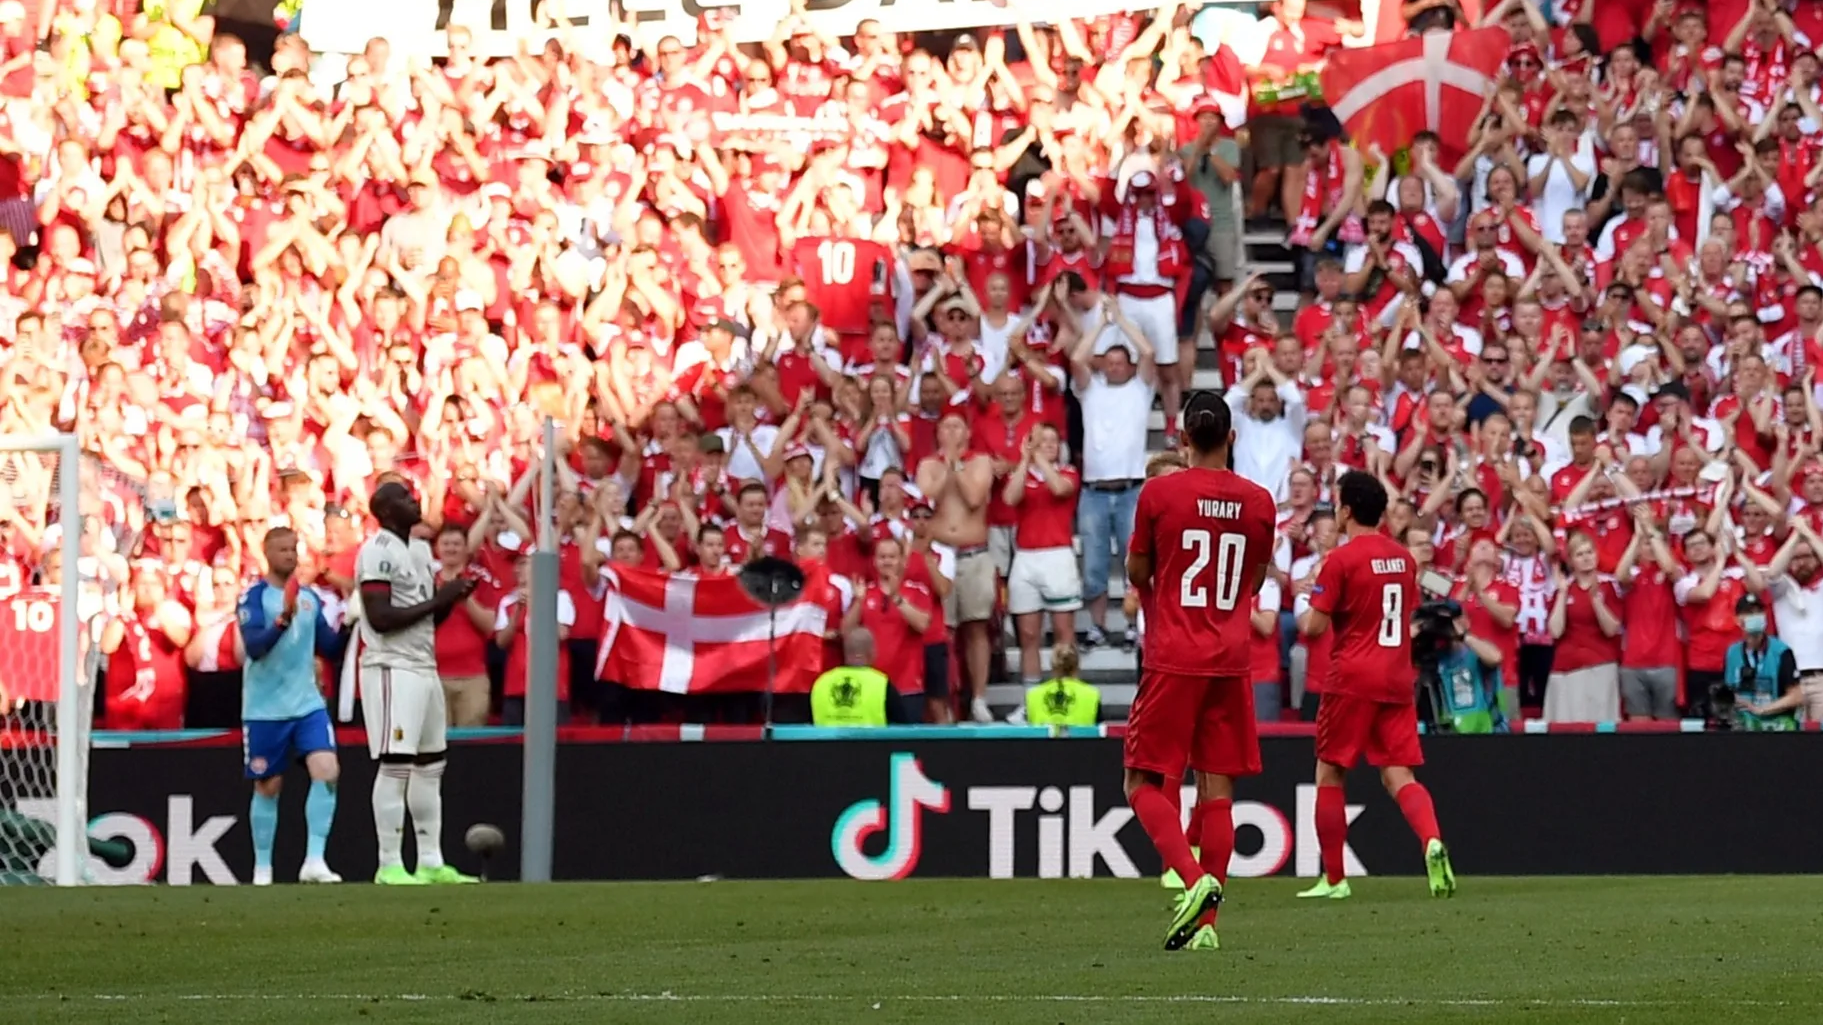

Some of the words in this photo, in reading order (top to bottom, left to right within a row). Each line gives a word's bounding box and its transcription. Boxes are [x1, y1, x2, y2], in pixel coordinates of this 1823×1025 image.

[817, 240, 856, 285] 10
[1197, 498, 1242, 520] YURARY
[1181, 529, 1247, 611] 20
[10, 599, 55, 633] 10
[1378, 582, 1403, 647] 8
[968, 785, 1368, 879] Tikok
